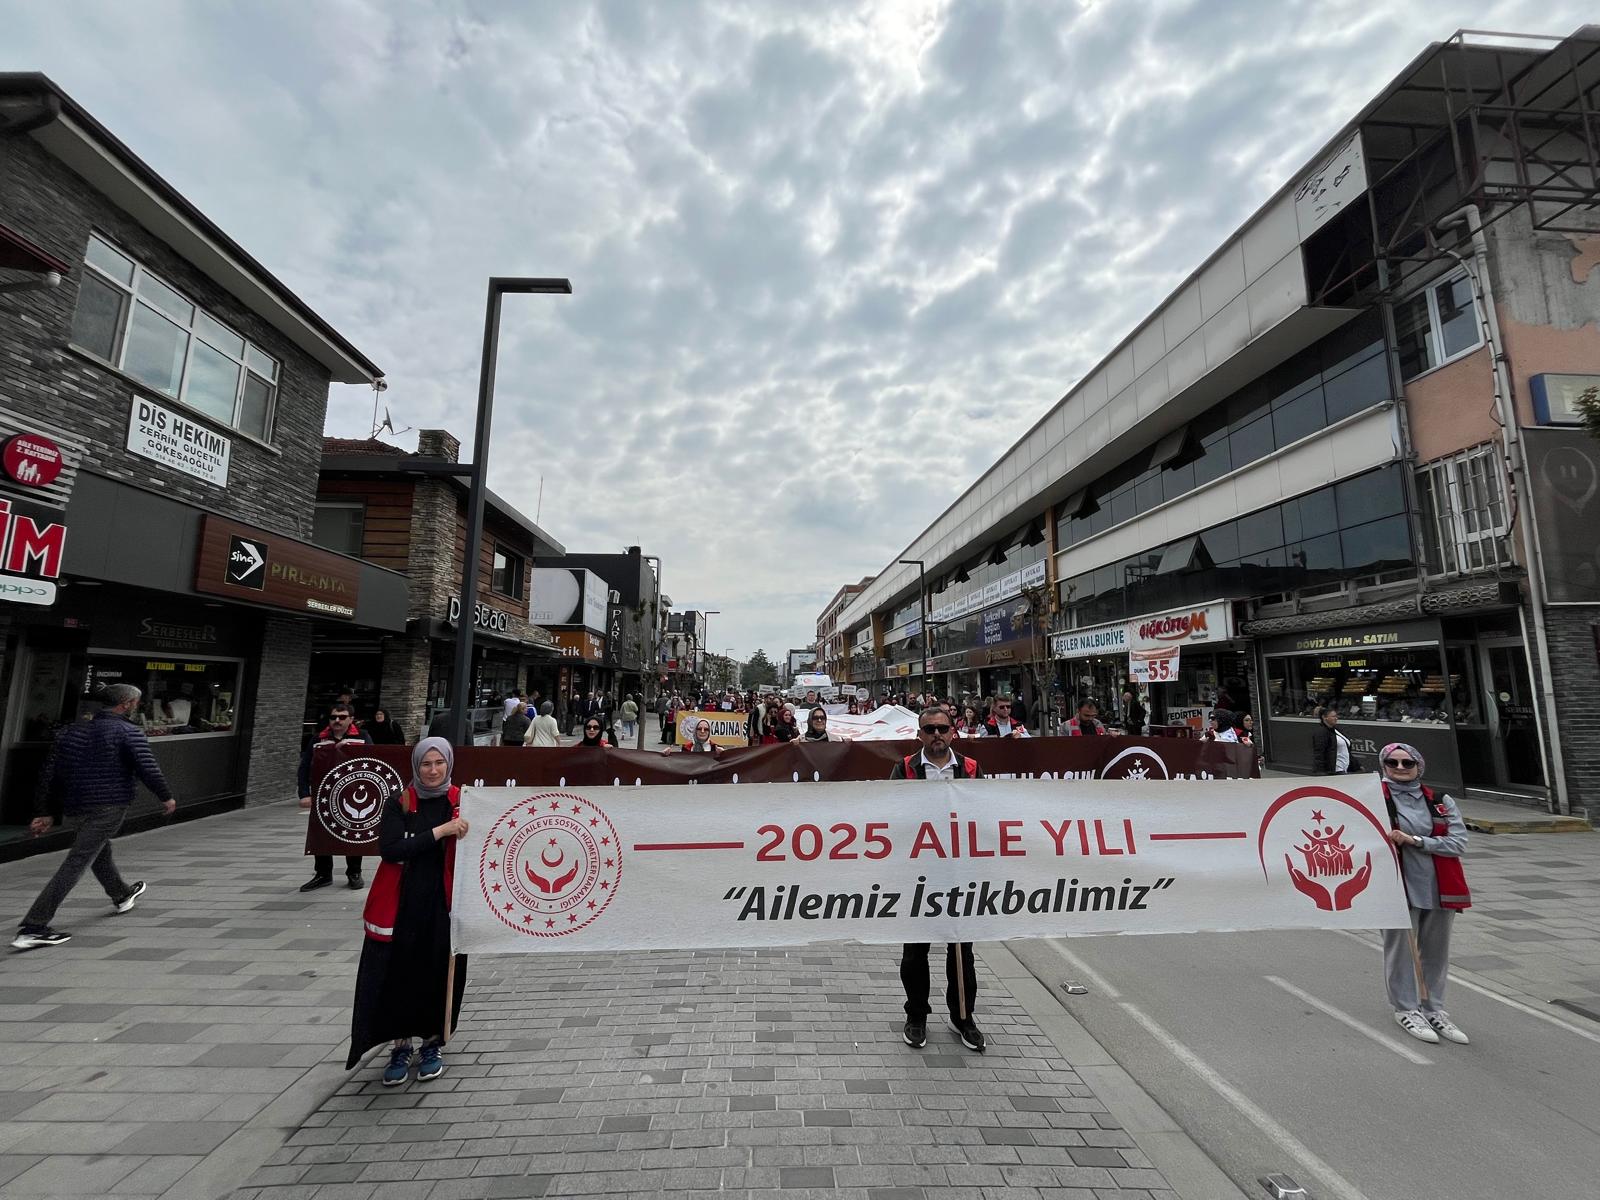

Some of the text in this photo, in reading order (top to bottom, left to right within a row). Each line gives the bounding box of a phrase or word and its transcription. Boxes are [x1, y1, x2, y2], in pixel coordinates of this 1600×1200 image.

[138, 402, 226, 458] DİŞ HEKİMİ
[140, 424, 178, 446] ZERRİN
[0, 584, 47, 596] ppo
[449, 598, 509, 632] pstacı
[610, 609, 622, 663] PARLA
[1080, 628, 1125, 649] NALBURİYE
[1327, 637, 1352, 647] ALIM
[1363, 633, 1398, 644] SATIM
[525, 822, 542, 833] AİLE
[554, 818, 581, 835] SOSYAL
[756, 812, 1136, 861] 2025 AİLE YILI
[506, 831, 526, 885] CUMHURİYETİ
[581, 832, 598, 875] HİZMETLER
[513, 886, 540, 909] TÜRKİYE
[560, 876, 595, 909] BAKANLIĞI
[722, 875, 1176, 921] “Ailemiz İstikbalimiz”
